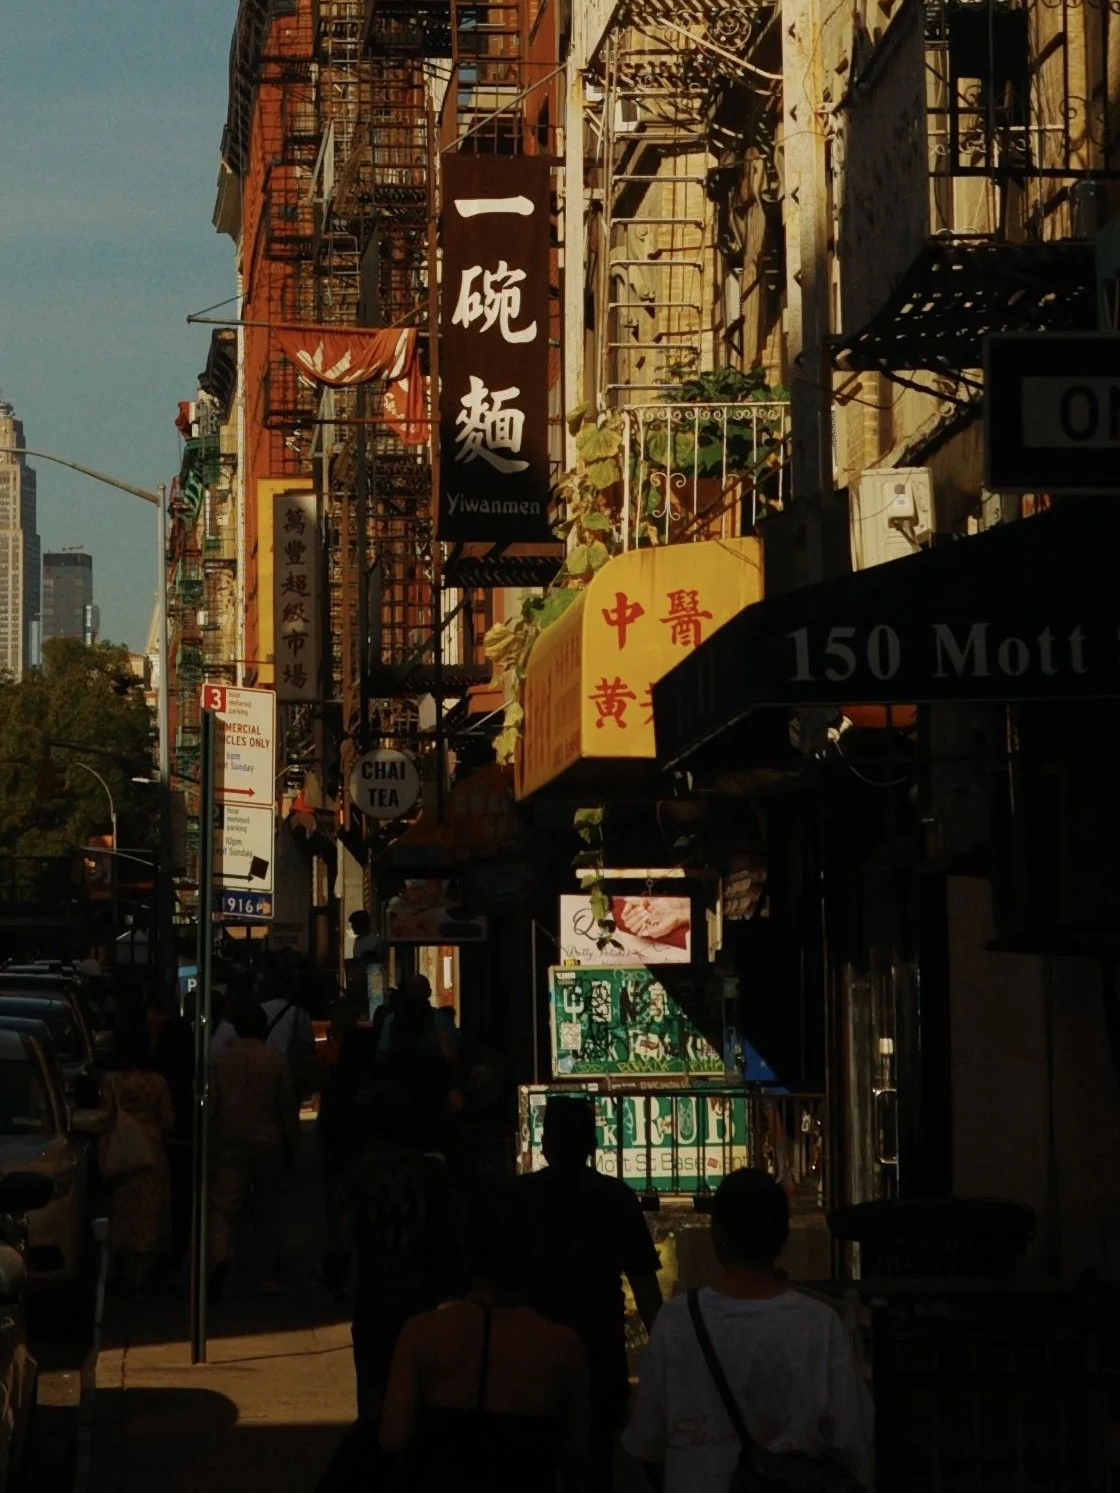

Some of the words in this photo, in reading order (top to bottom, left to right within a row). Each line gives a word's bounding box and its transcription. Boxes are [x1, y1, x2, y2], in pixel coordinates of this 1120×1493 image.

[1061, 384, 1120, 442] O
[446, 489, 541, 515] Yiwanmen
[281, 507, 312, 690] 萬豐超級市場
[785, 624, 901, 682] 150
[931, 622, 1090, 678] Mott
[210, 688, 222, 710] 3
[249, 737, 270, 749] ONLY
[362, 761, 405, 780] CHAI
[368, 789, 399, 807] TEA
[631, 1096, 736, 1146] RUB
